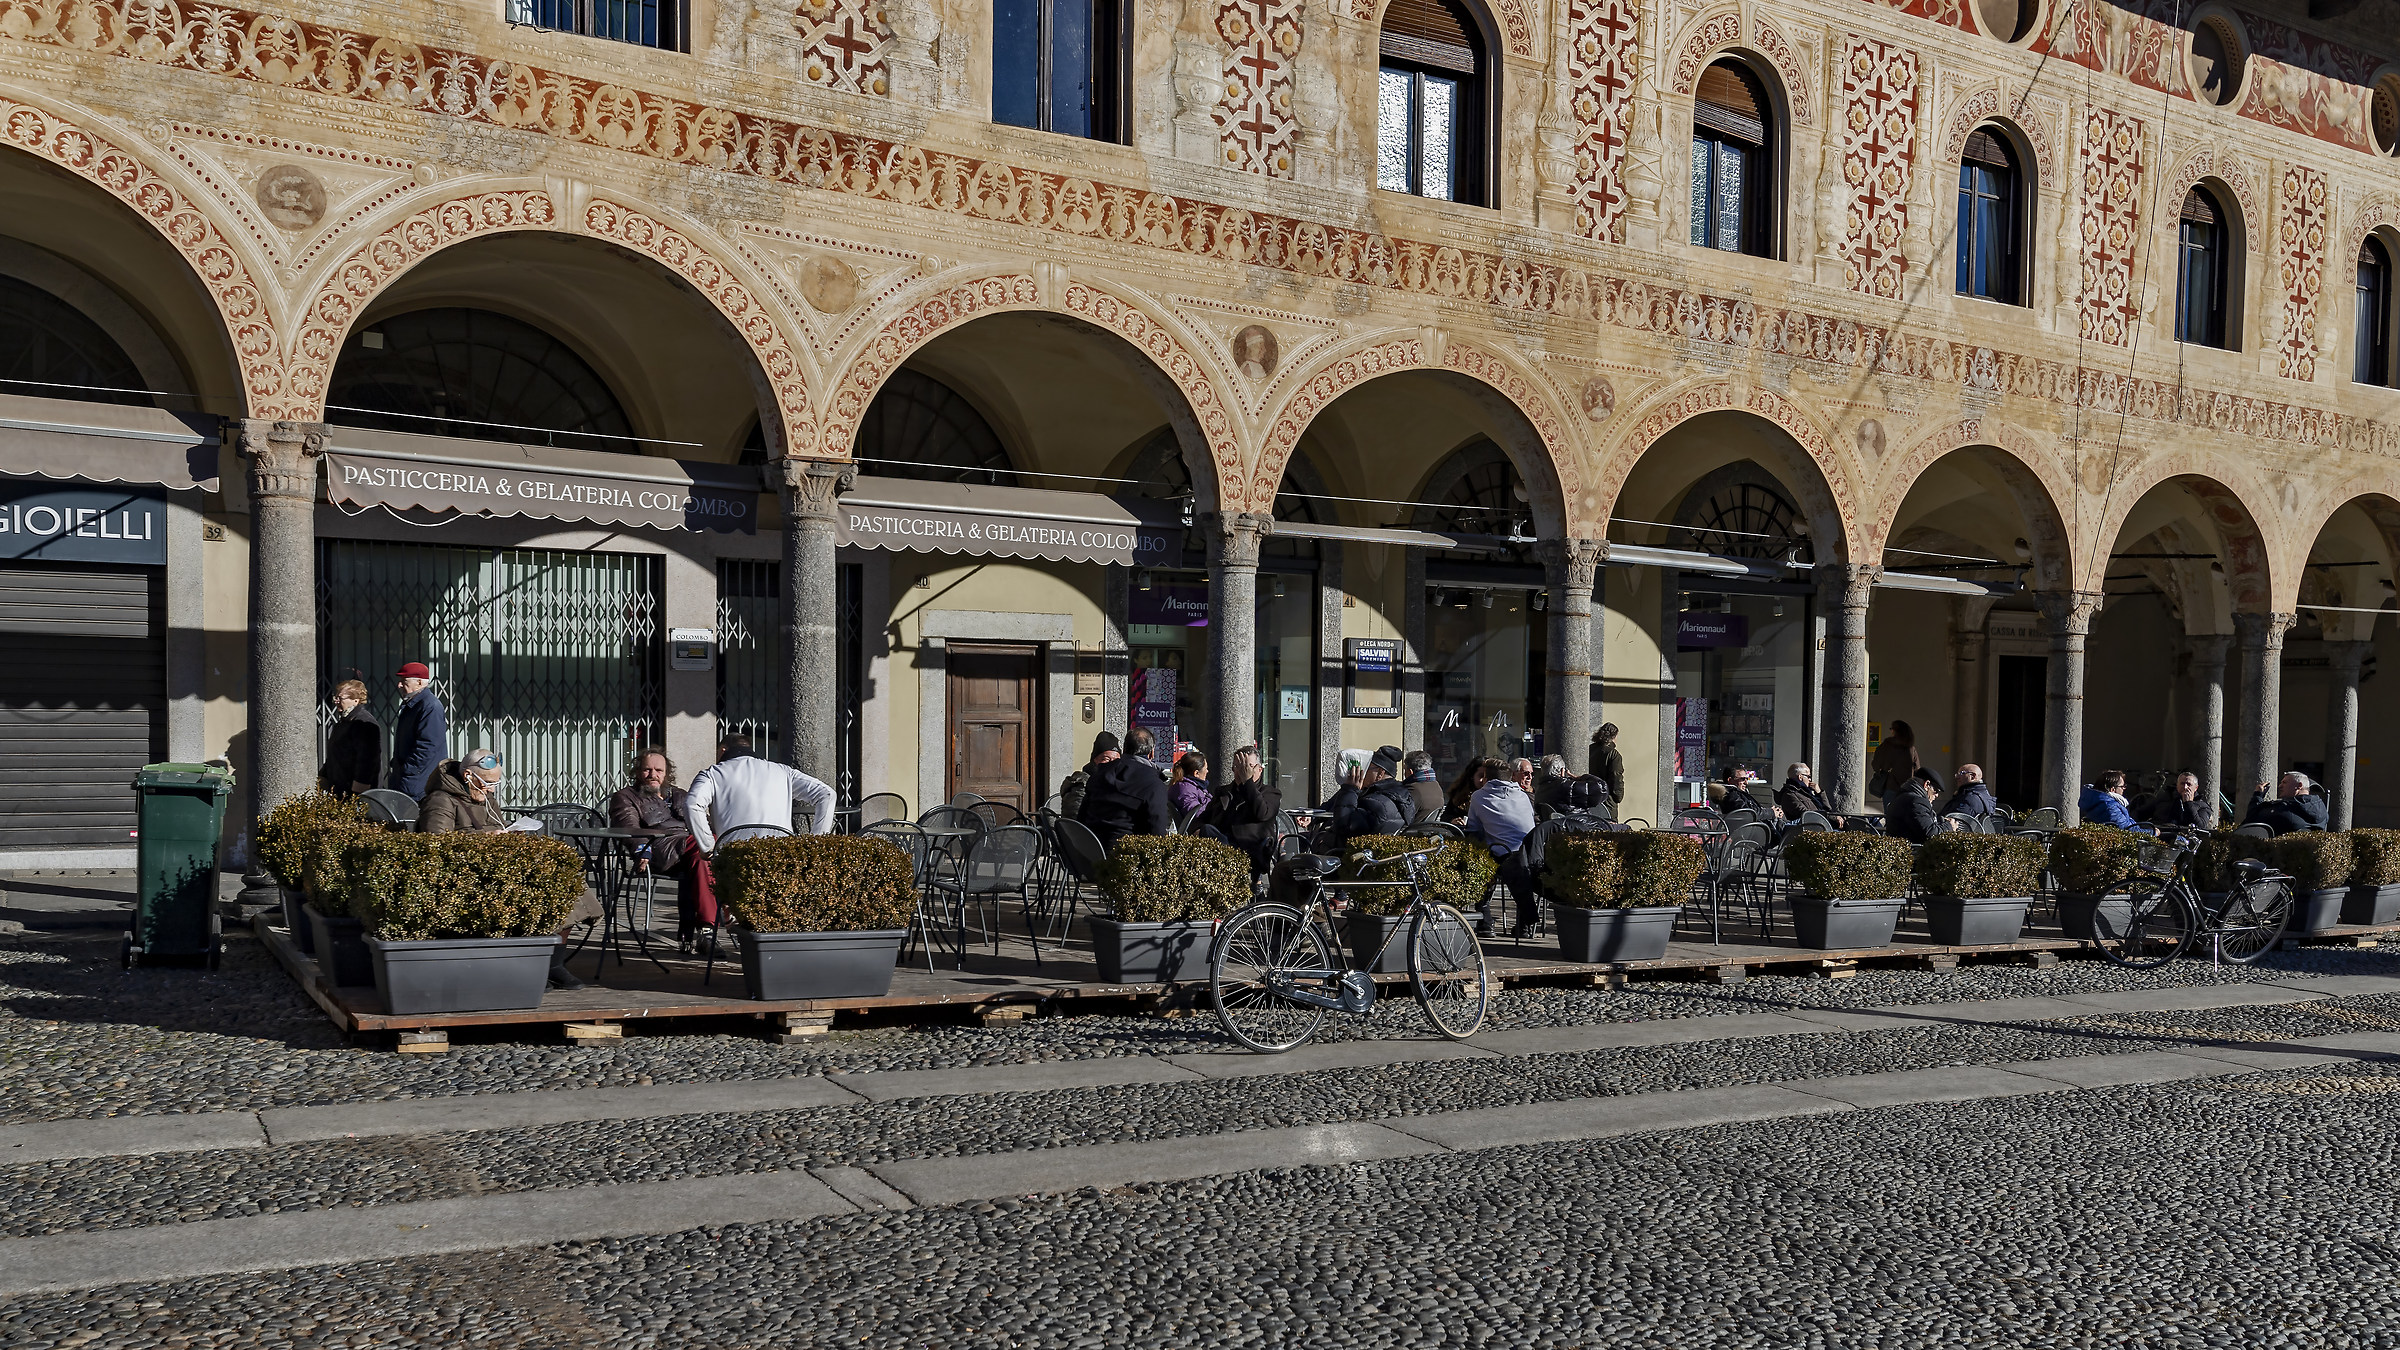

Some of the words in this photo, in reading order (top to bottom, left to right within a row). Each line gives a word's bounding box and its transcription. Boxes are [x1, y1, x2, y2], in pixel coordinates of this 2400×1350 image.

[343, 465, 491, 495] PASTICCERIA
[495, 478, 513, 497] &
[517, 480, 635, 508] GELATERIA
[639, 491, 746, 518] COLOMBO
[205, 525, 222, 539] 39
[849, 514, 965, 538] PASTICCERIA
[968, 522, 982, 540] &
[985, 523, 1077, 546] GELATERIA
[1080, 531, 1167, 552] COLOMBO
[1160, 595, 1209, 612] Marionn
[1344, 596, 1353, 607] 41
[1677, 619, 1727, 634] Marionnaud
[1990, 626, 2016, 637] CASSA
[1377, 640, 1391, 648] NORD
[1359, 648, 1389, 658] SALVINI
[1368, 707, 1399, 715] LOMBARDA
